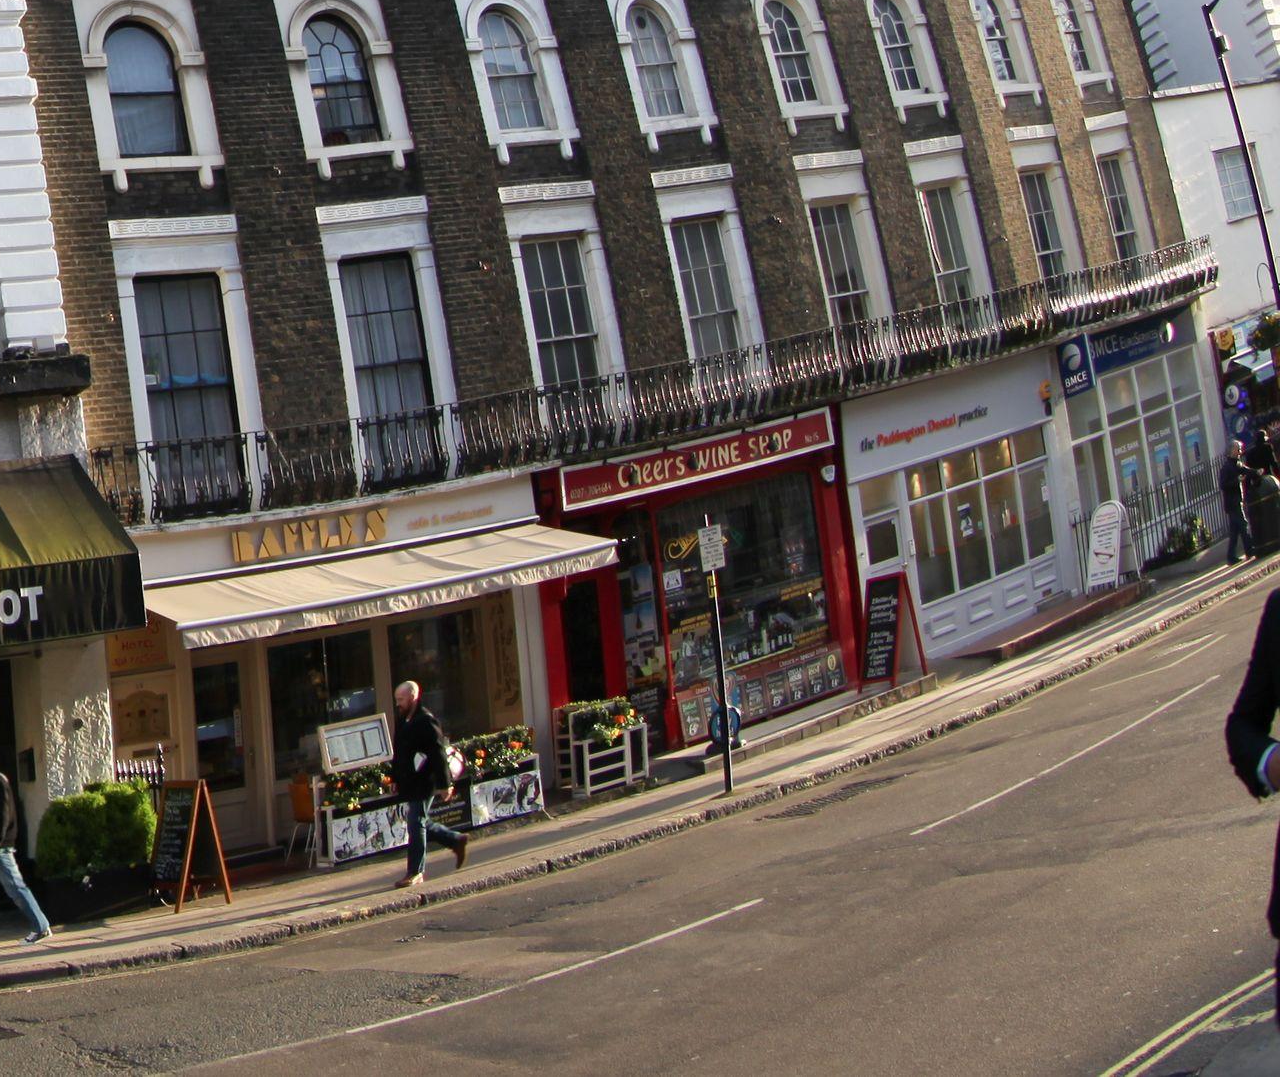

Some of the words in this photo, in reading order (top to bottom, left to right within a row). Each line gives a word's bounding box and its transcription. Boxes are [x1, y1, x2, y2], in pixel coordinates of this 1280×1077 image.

[1089, 334, 1119, 360] BMCE
[1064, 371, 1088, 388] BMCE
[693, 441, 742, 472] WINE
[748, 428, 792, 458] SHOP
[861, 437, 874, 452] the
[876, 425, 926, 448] Paddington
[926, 413, 956, 433] Dental
[958, 405, 988, 427] practice
[231, 507, 389, 564] RAFFLES
